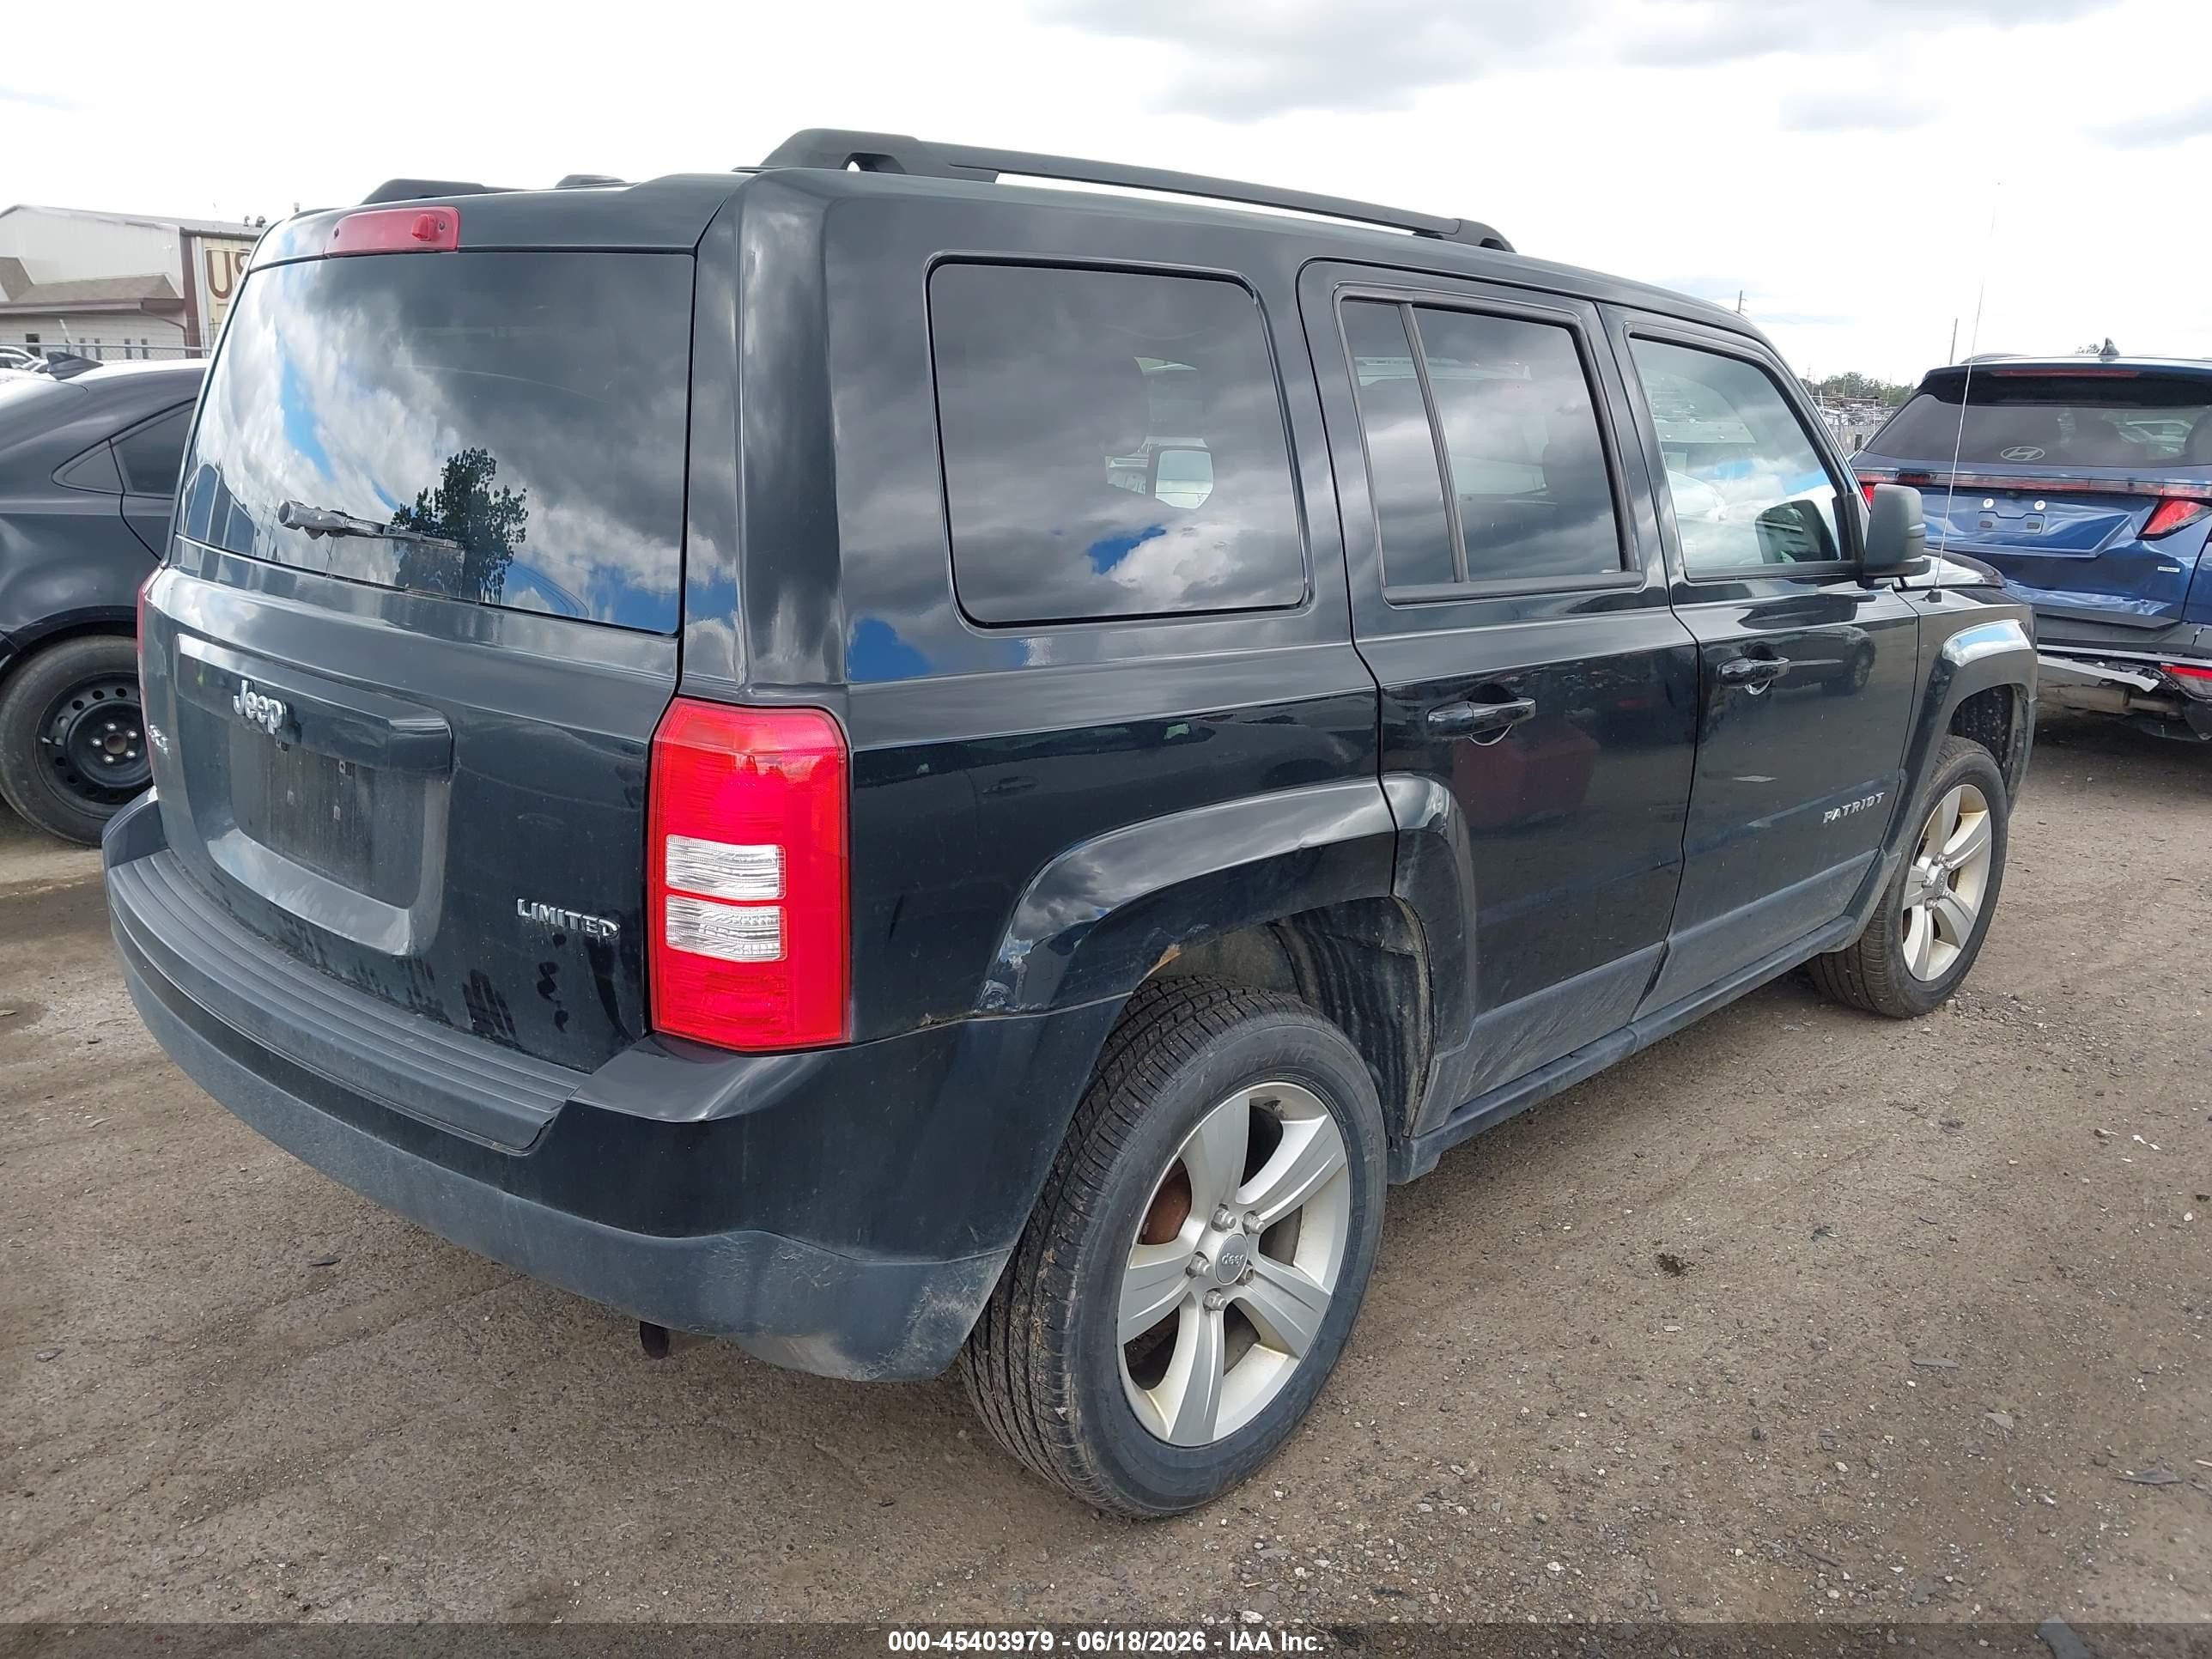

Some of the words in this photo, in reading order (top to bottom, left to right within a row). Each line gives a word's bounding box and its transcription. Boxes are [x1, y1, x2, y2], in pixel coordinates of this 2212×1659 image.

[233, 679, 287, 735] Jeep
[1822, 792, 1886, 824] PATRIOT
[517, 898, 620, 939] LIMITED
